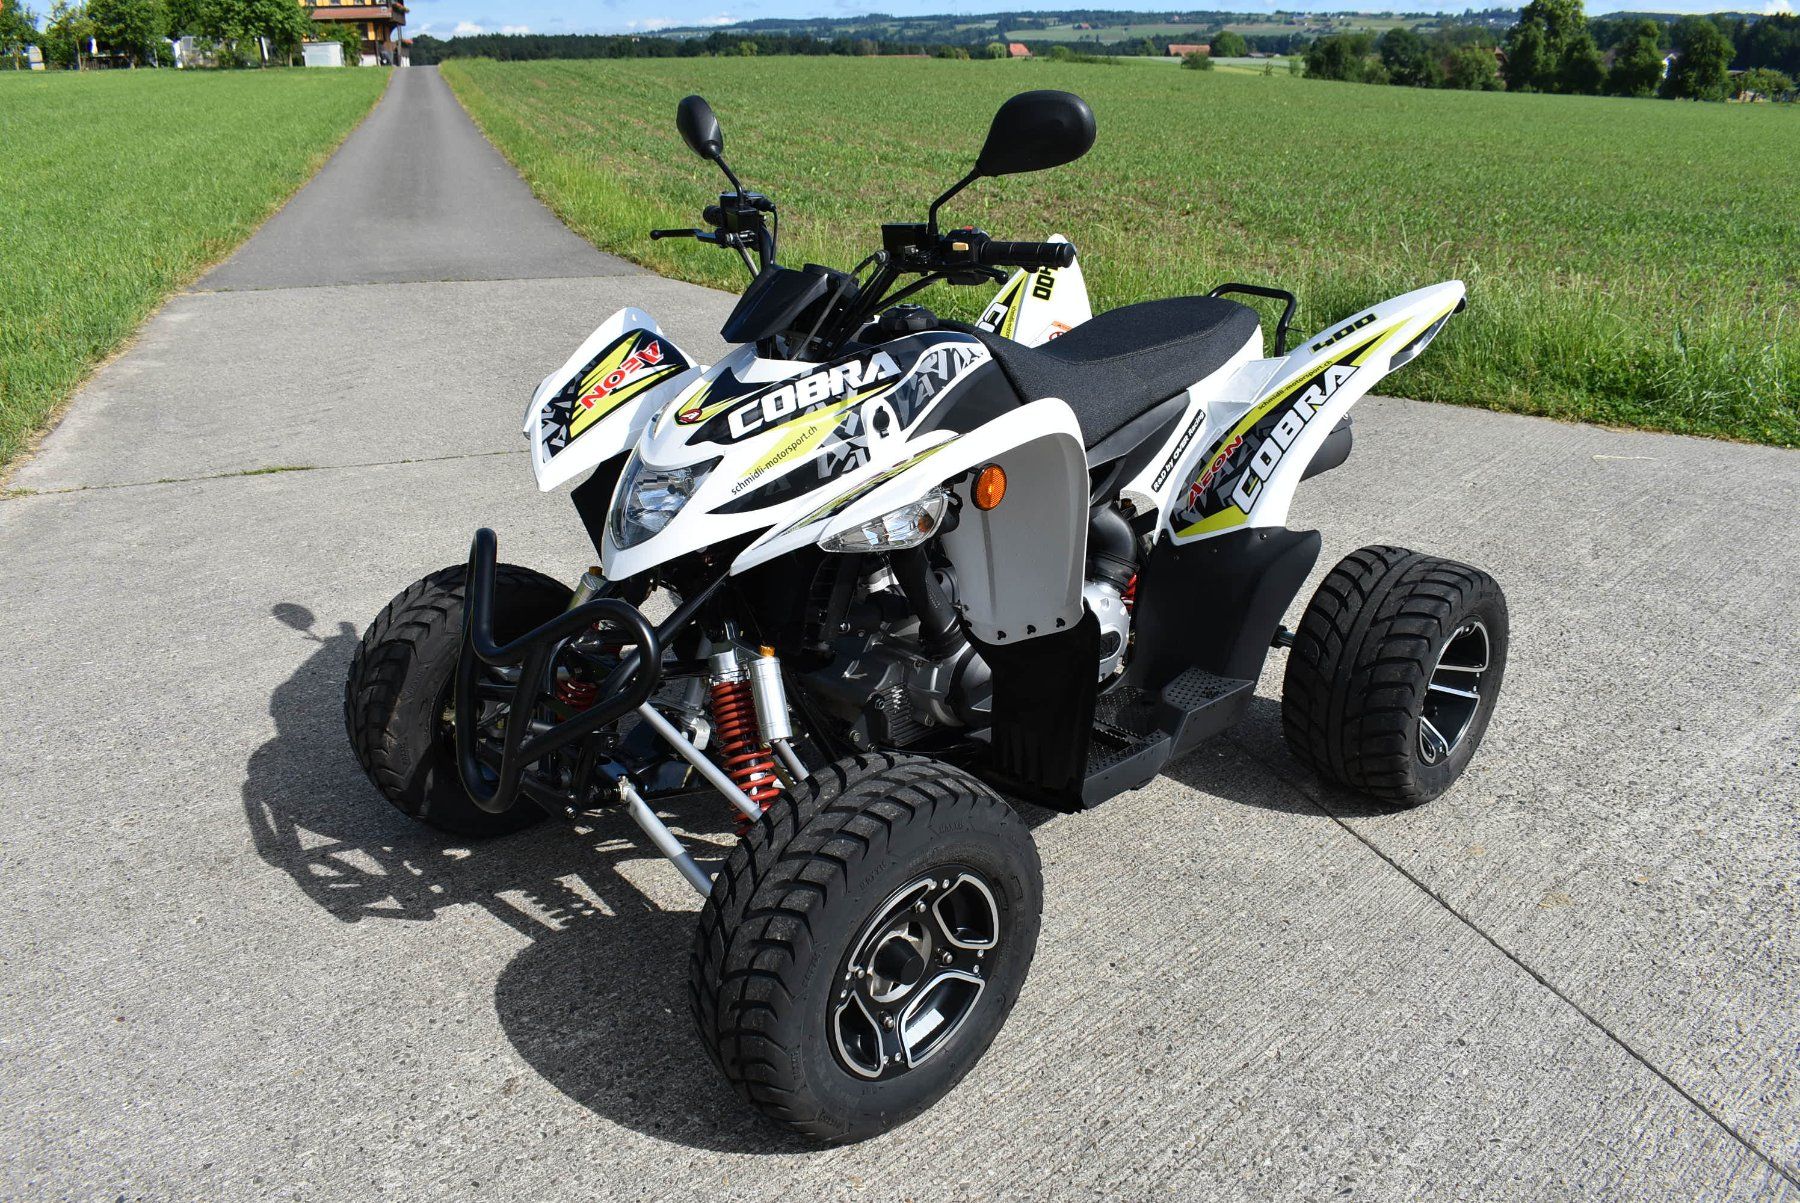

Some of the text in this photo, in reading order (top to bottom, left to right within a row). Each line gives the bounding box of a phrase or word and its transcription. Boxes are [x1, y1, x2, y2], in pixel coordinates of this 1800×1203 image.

[1312, 313, 1376, 352] 400
[580, 340, 664, 409] AEON
[727, 350, 901, 439] COBRA
[1258, 361, 1332, 410] schmidli-motorsport.ch
[731, 425, 818, 495] schmidli-motorsport.ch
[1165, 458, 1174, 471] by
[1187, 411, 1205, 436] Racing
[1188, 434, 1243, 513] AEON
[1231, 364, 1360, 514] COBRA
